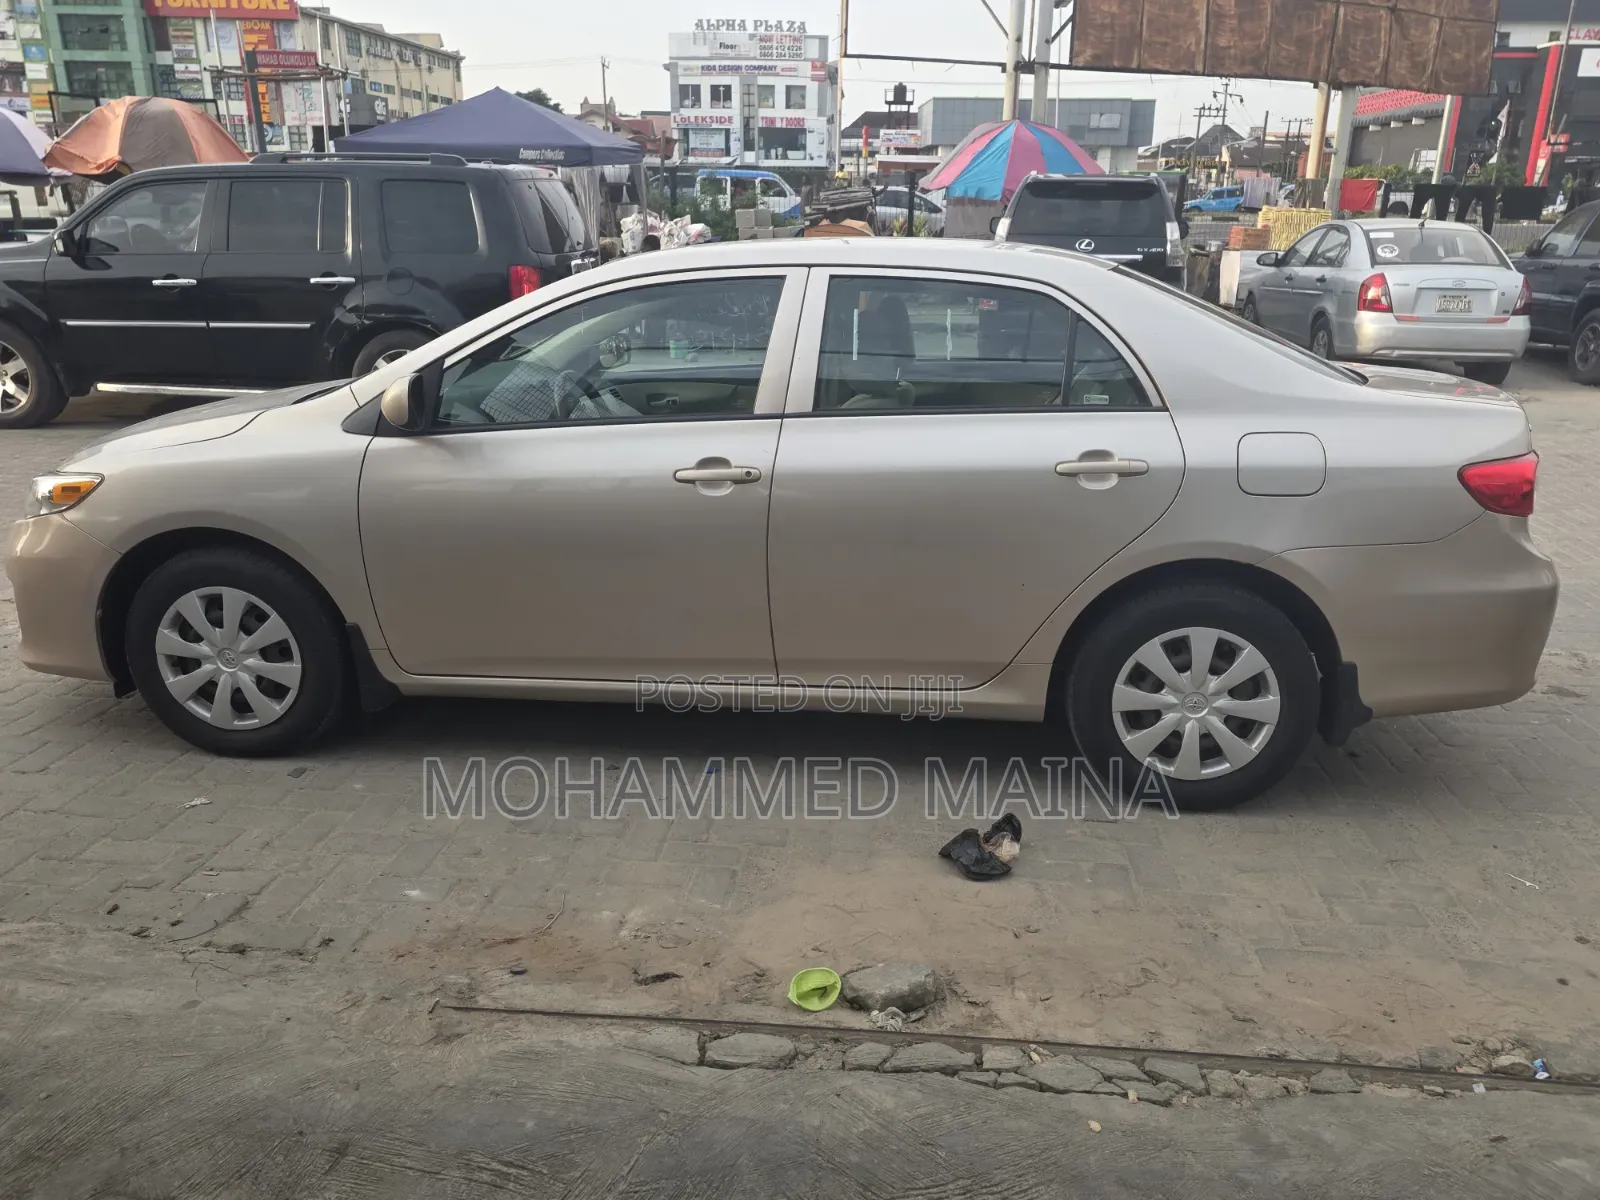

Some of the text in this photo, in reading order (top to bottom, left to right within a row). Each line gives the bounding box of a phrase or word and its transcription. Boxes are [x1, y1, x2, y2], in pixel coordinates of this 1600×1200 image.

[695, 18, 808, 33] ALPHA PLAZA
[719, 42, 737, 50] Floor
